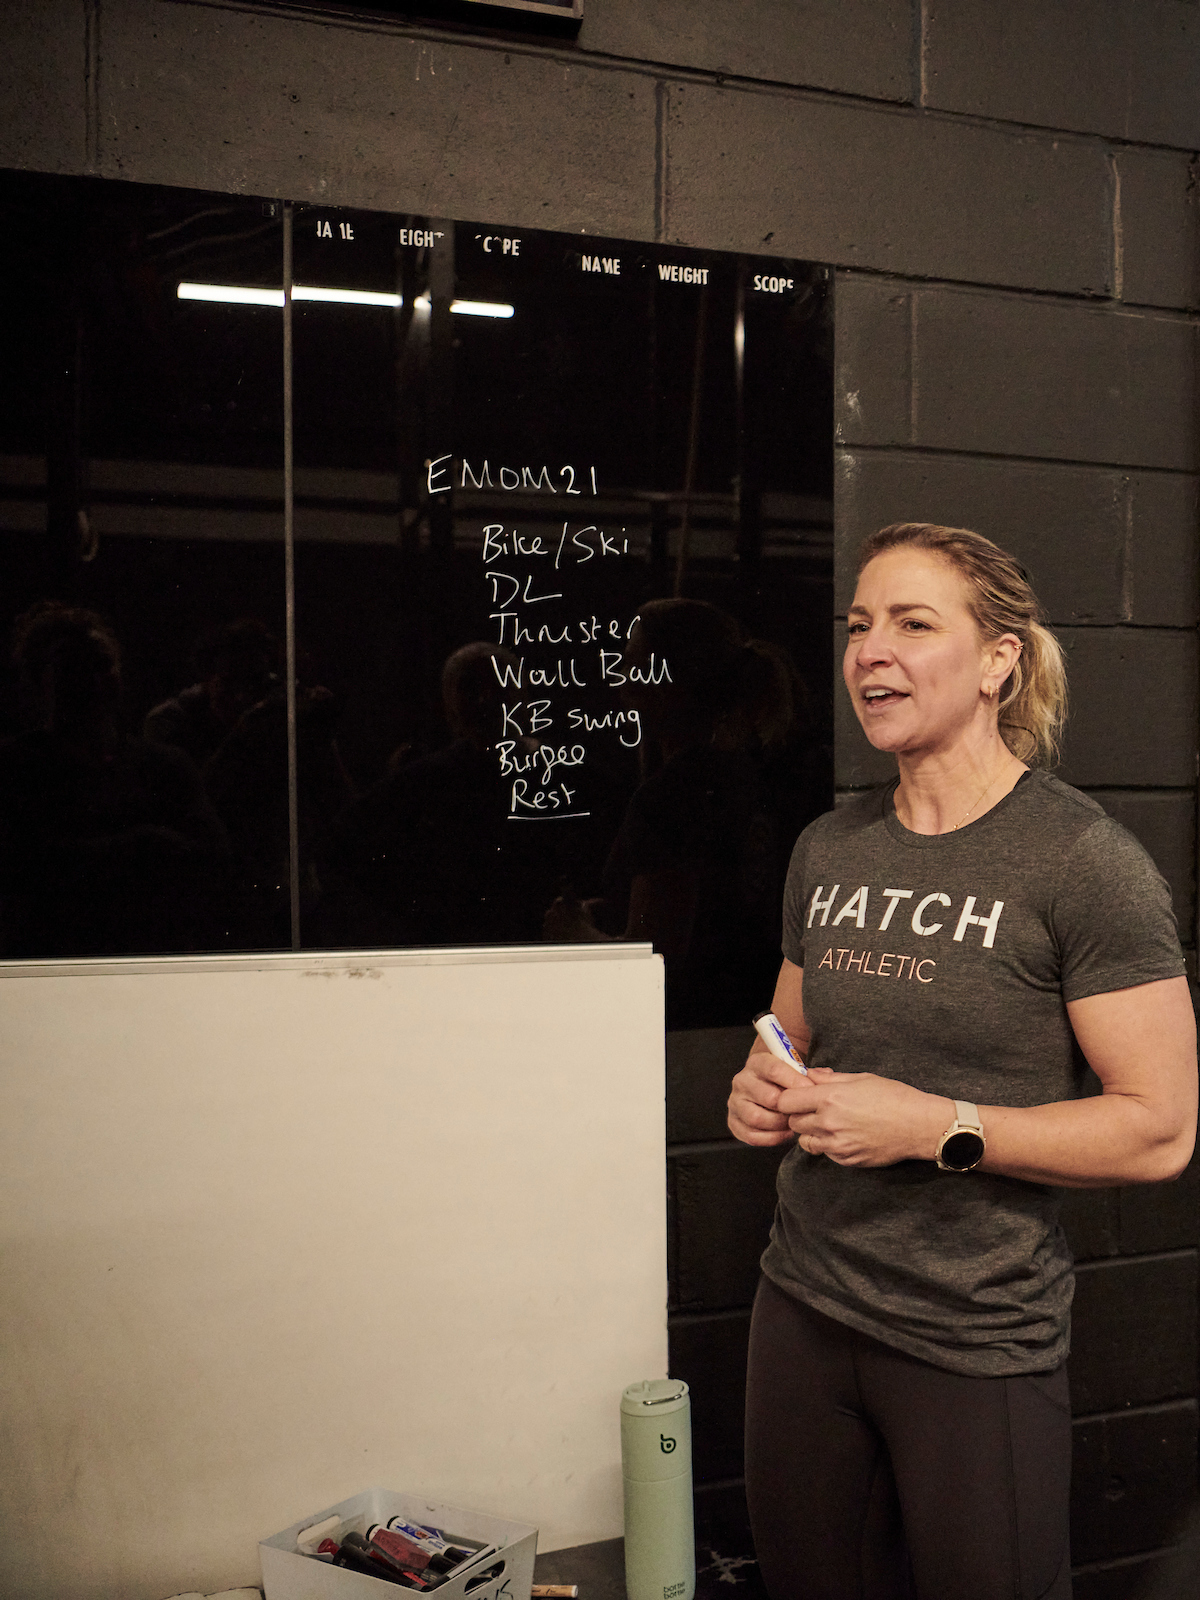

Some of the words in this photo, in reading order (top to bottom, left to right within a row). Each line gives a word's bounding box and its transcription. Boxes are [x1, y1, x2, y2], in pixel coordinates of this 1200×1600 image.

[473, 234, 522, 256] CPE
[658, 264, 709, 285] WEIGHT
[485, 571, 563, 608] DL
[489, 612, 641, 645] Thruster
[490, 655, 587, 689] Wall
[599, 648, 673, 687] Ball
[502, 700, 553, 736] KB
[567, 708, 642, 747] swing
[495, 740, 585, 785] Burpee
[511, 778, 576, 813] Rest
[807, 884, 1004, 949] HATCH
[818, 947, 937, 983] ATHLETIC
